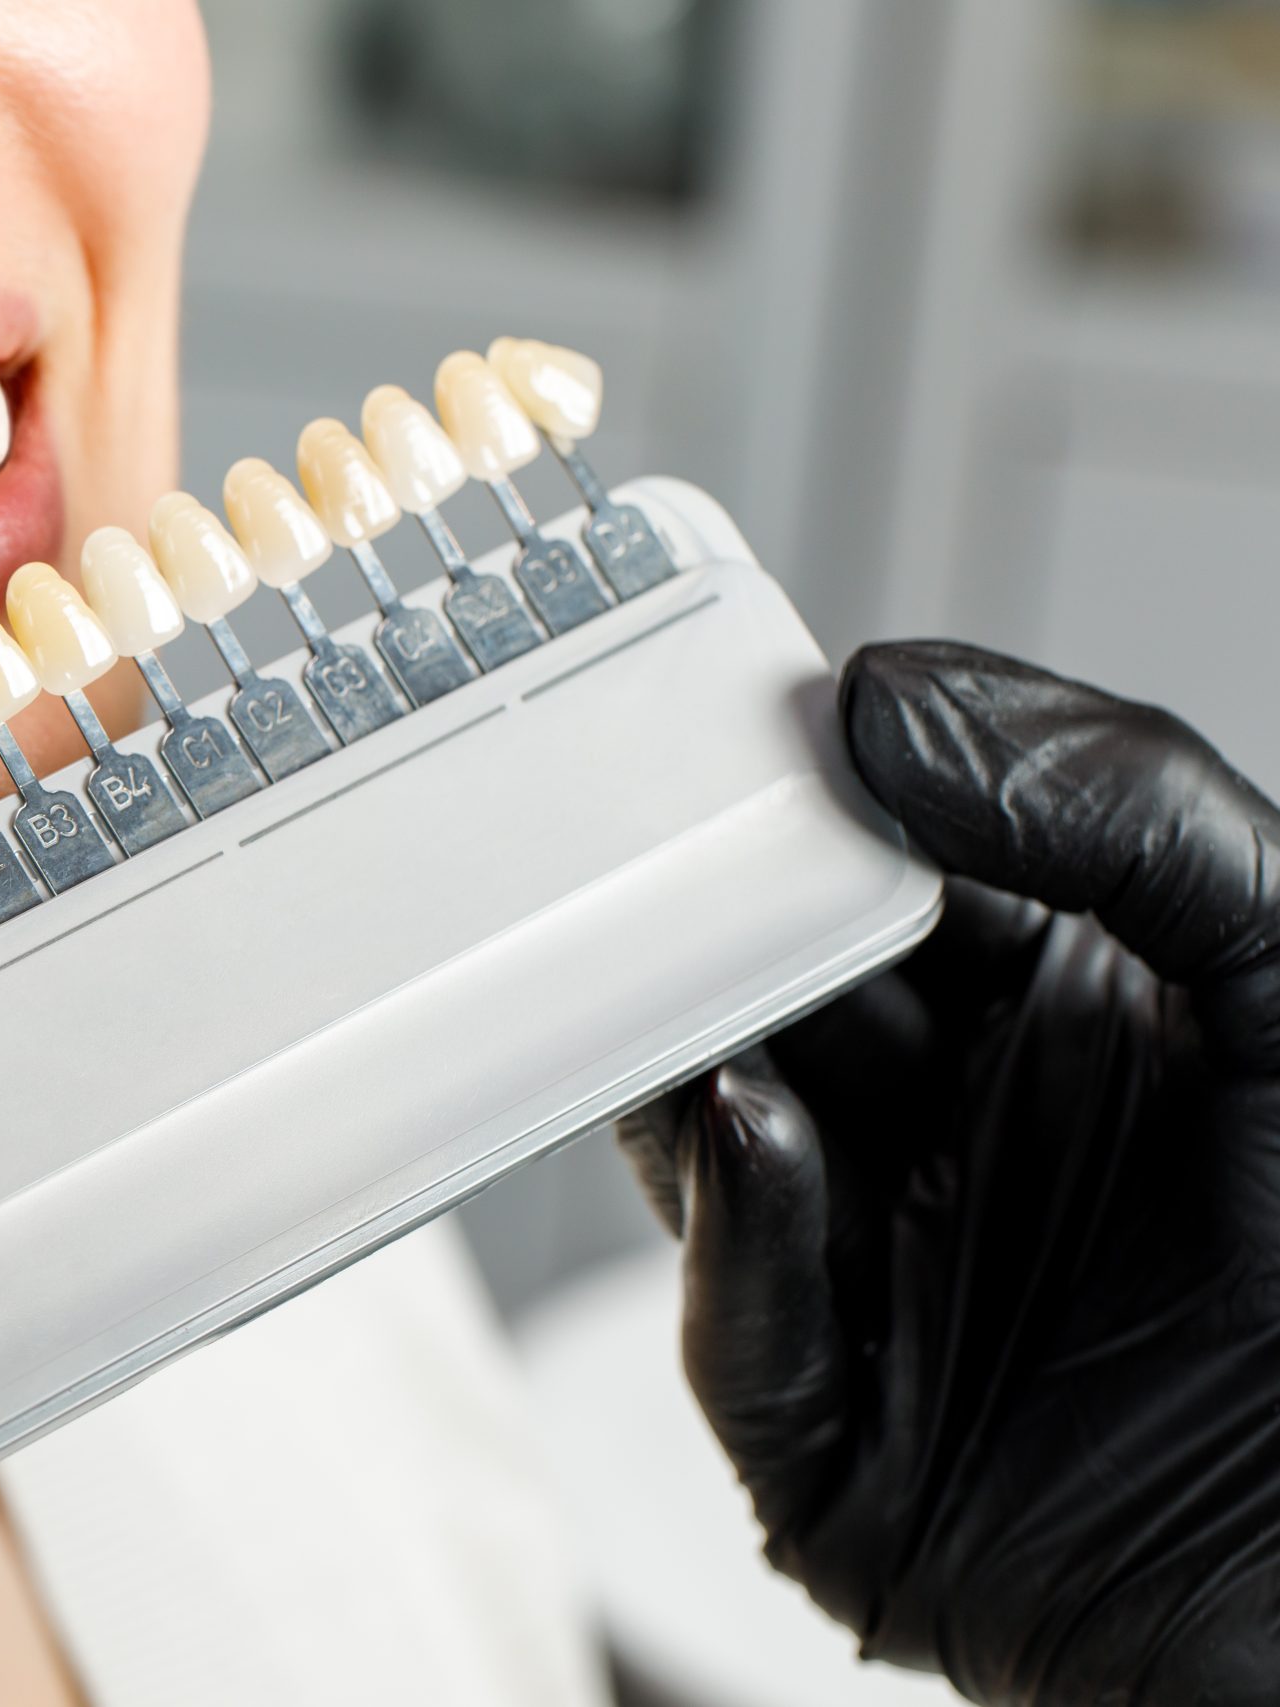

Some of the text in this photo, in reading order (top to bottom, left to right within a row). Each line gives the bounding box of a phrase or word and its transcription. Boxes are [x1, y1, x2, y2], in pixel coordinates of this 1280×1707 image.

[527, 548, 577, 594] D3
[322, 656, 366, 698] C3
[246, 691, 293, 732] C2
[181, 729, 223, 768] C1
[100, 767, 152, 811] B4
[27, 804, 78, 849] B3
